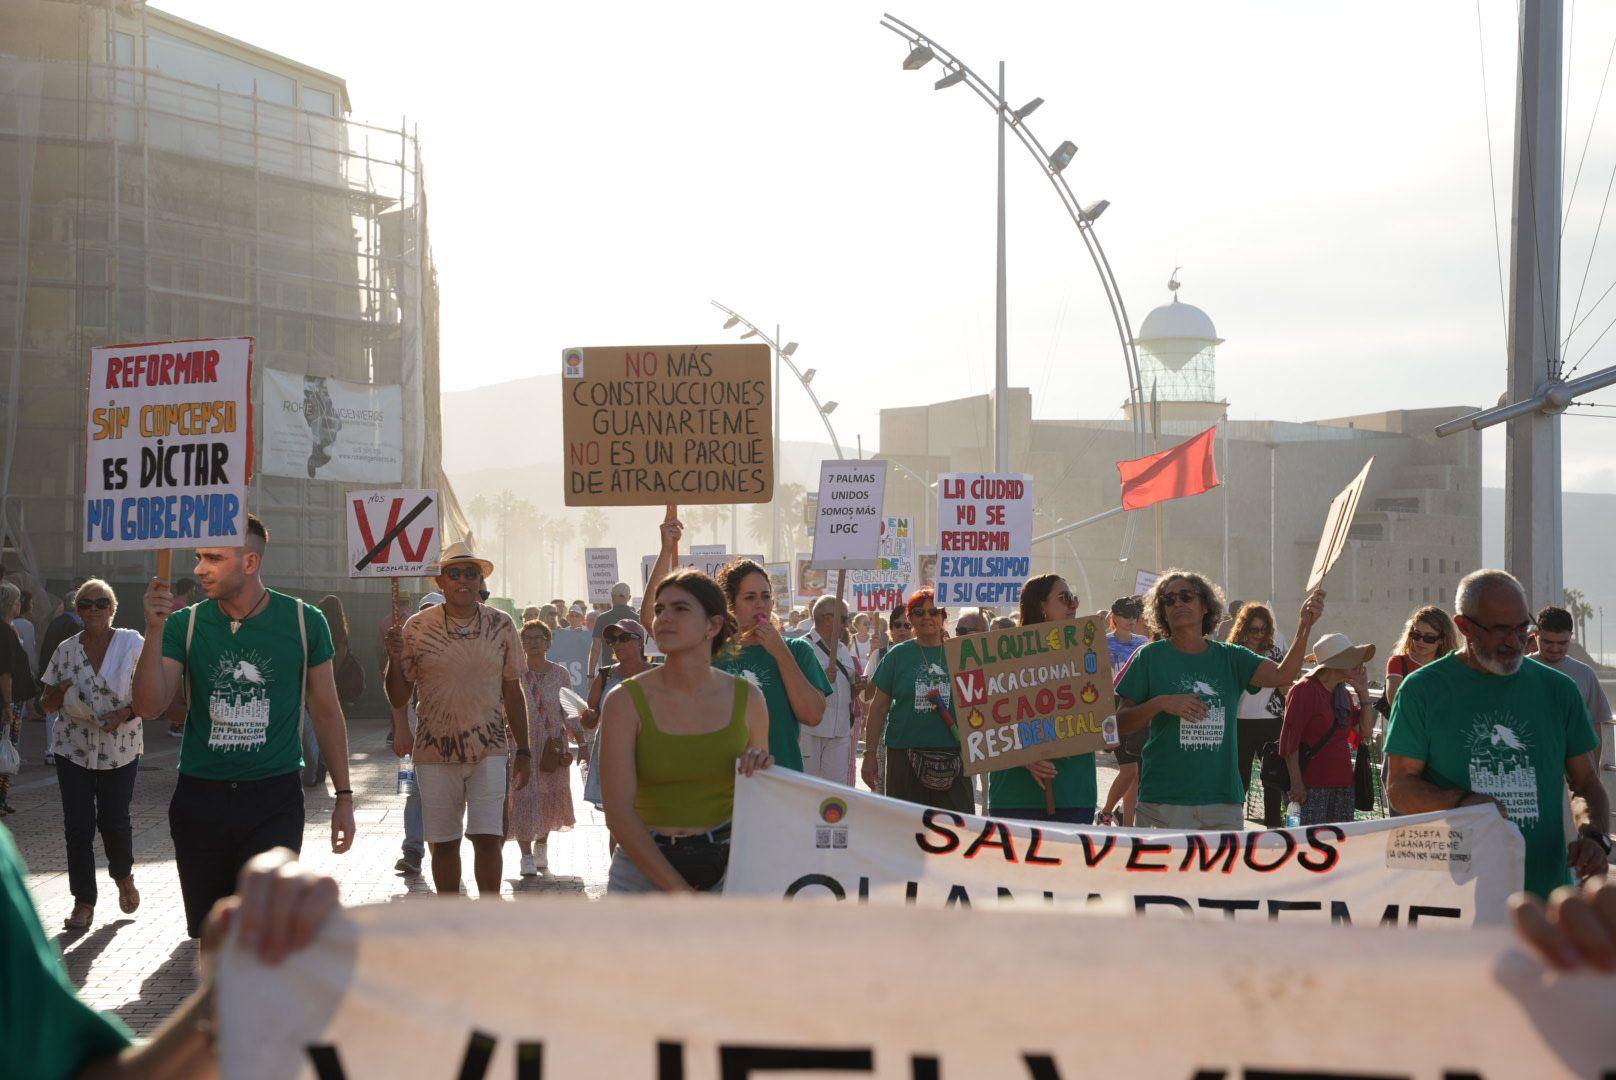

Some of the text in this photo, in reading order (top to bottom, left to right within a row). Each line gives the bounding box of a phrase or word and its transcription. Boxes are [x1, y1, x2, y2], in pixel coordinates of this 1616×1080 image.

[105, 350, 220, 389] REFORMAR
[625, 346, 713, 378] NO MÁS
[573, 380, 765, 407] CONSTRUCCIONES
[139, 400, 237, 439] CONCENSO
[592, 408, 759, 436] GUANARTEME
[570, 438, 764, 467] NO ES UN PARQUE
[102, 457, 128, 491] ES
[572, 468, 765, 494] DE ATRACCIONES
[828, 474, 876, 484] 7 PALMAS
[367, 495, 384, 504] NOS
[831, 490, 869, 500] UNIDOS
[944, 479, 966, 499] LA
[87, 493, 240, 542] NO GOBERNAR
[821, 505, 876, 516] SOMOS MÁS
[957, 505, 1006, 526] NO SE
[830, 523, 859, 535] LPGC
[941, 531, 1010, 552] REFORMA
[940, 556, 1030, 577] EXPULSANDO
[857, 590, 904, 611] LUCHA
[938, 582, 1022, 603] A SU GENTE
[992, 685, 1075, 724] CAOS
[967, 711, 1102, 764] RESIDENCIAL
[915, 808, 1346, 874] SALVEMOS
[1409, 830, 1440, 838] ISLETA
[1394, 841, 1459, 850] GUANARTEME
